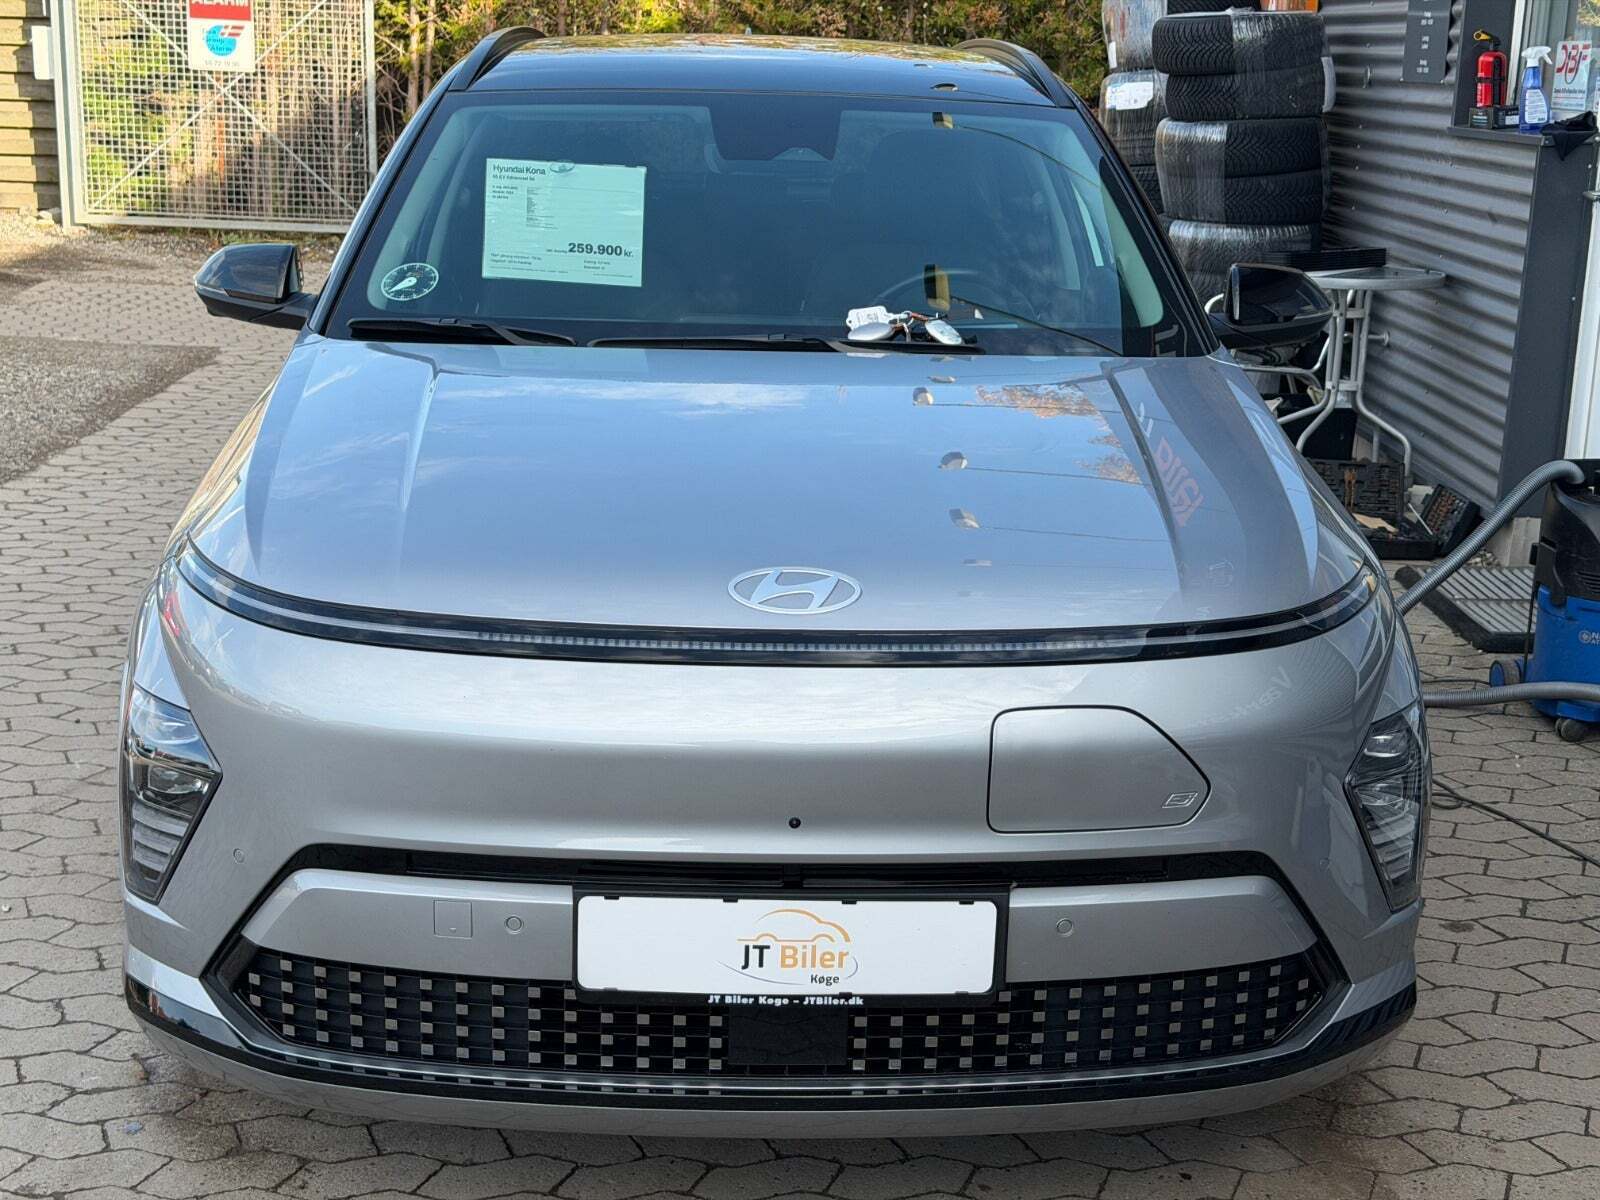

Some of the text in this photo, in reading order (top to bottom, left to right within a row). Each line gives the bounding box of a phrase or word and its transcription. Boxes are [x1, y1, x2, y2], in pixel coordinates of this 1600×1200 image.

[493, 163, 546, 175] Hyundai Kona
[568, 242, 623, 257] 259.900
[624, 248, 634, 258] kr.
[741, 944, 850, 971] JT Biler
[809, 973, 840, 986] Køge
[707, 994, 720, 1005] JT
[724, 994, 754, 1005] Biler
[803, 996, 864, 1007] JTBiler.dk
